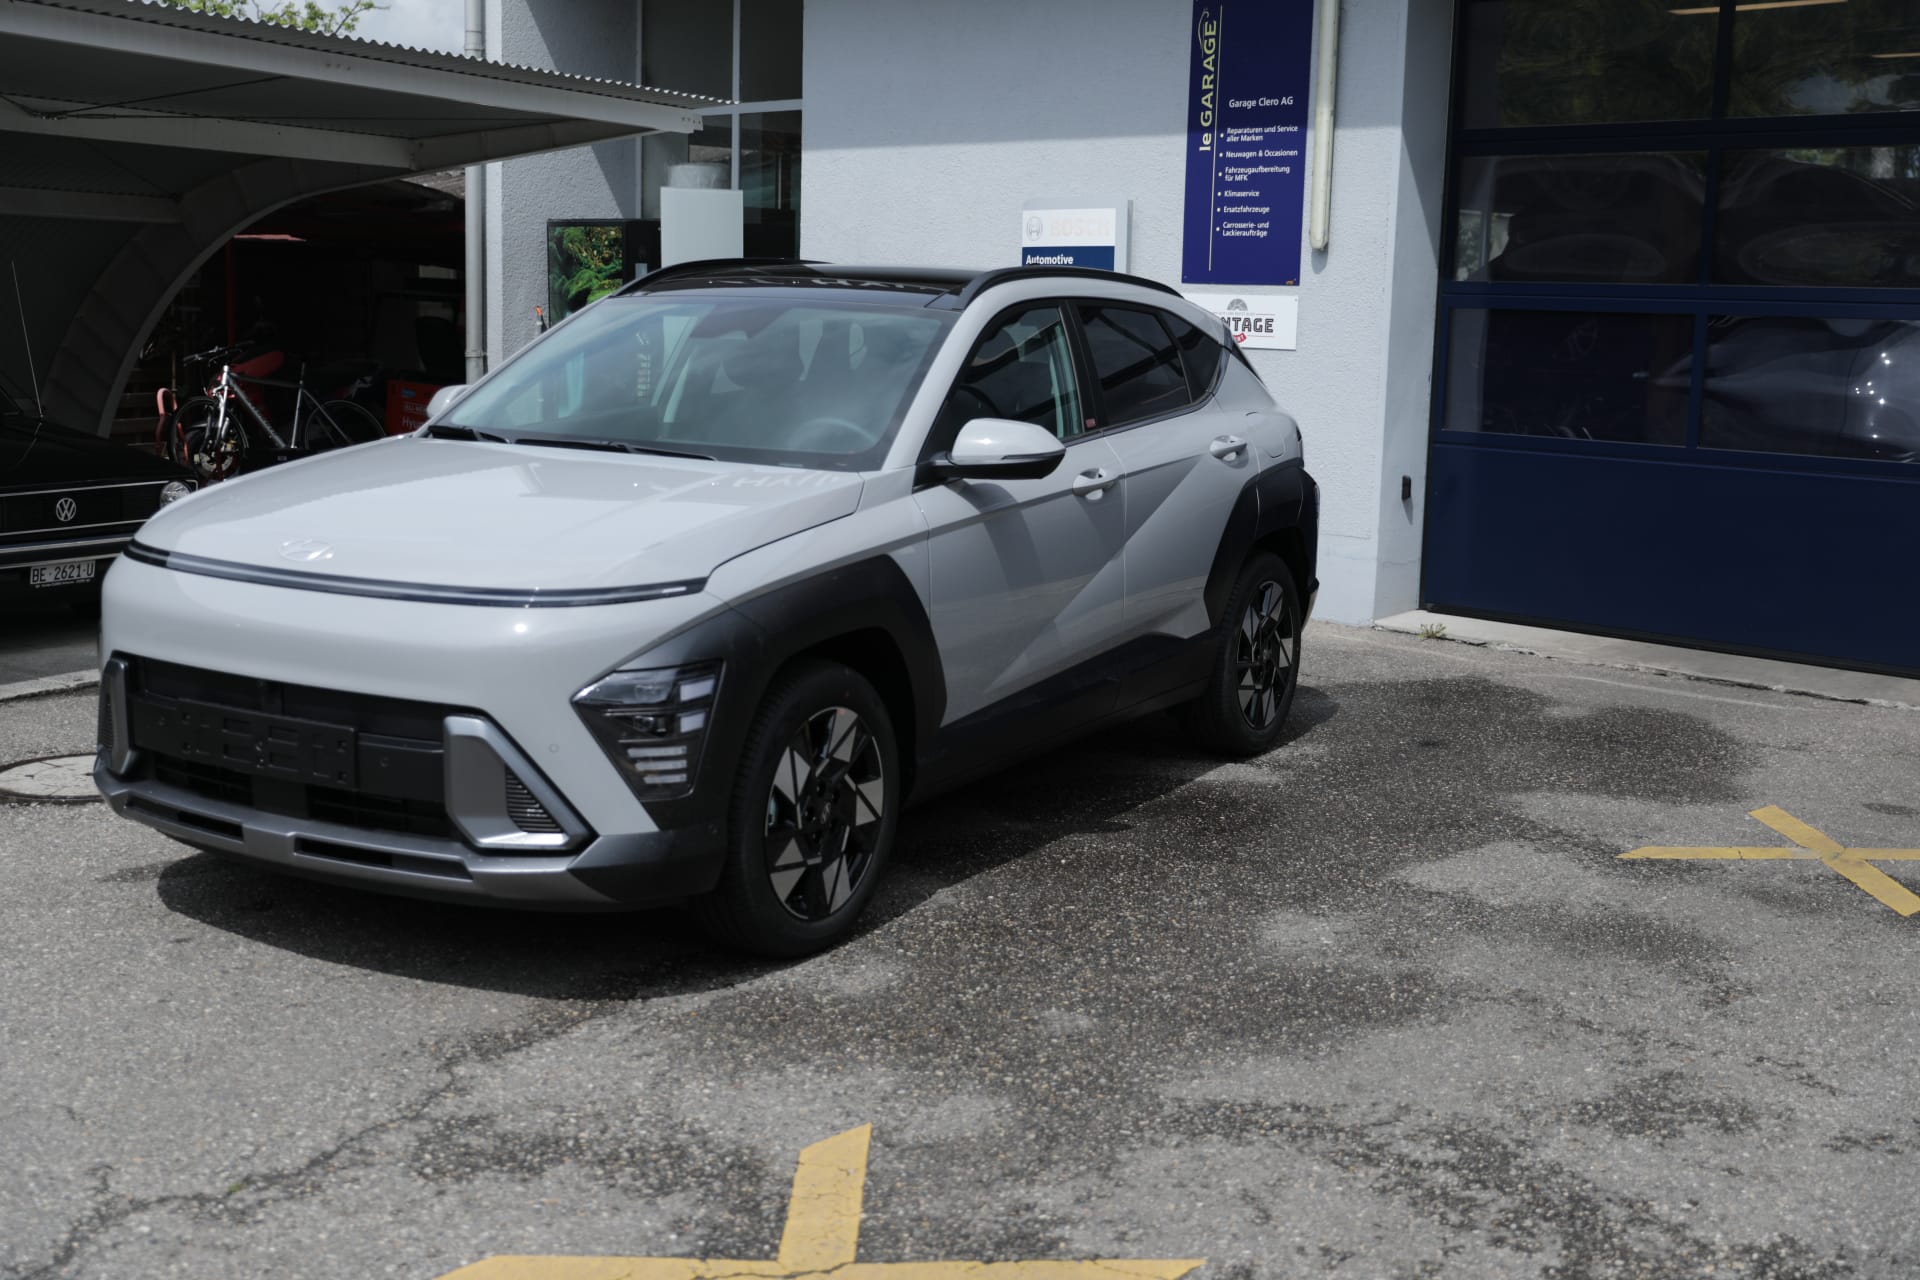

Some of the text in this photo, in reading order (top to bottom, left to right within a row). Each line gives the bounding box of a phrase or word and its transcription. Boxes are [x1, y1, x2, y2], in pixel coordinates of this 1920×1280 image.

[1199, 20, 1217, 152] le GARAGE
[1229, 96, 1294, 109] Garage Clero AG
[1227, 127, 1263, 135] Reparaturen
[1226, 151, 1257, 159] Neuwagen
[1264, 149, 1298, 157] Occasionen
[1225, 166, 1290, 174] Fahrzeugaufbereitung
[1223, 206, 1270, 214] Ersatzfahrzeuge
[1222, 221, 1269, 229] Carrosserie- und
[1222, 229, 1268, 238] Lackieraufträge
[1026, 254, 1074, 265] Automotive
